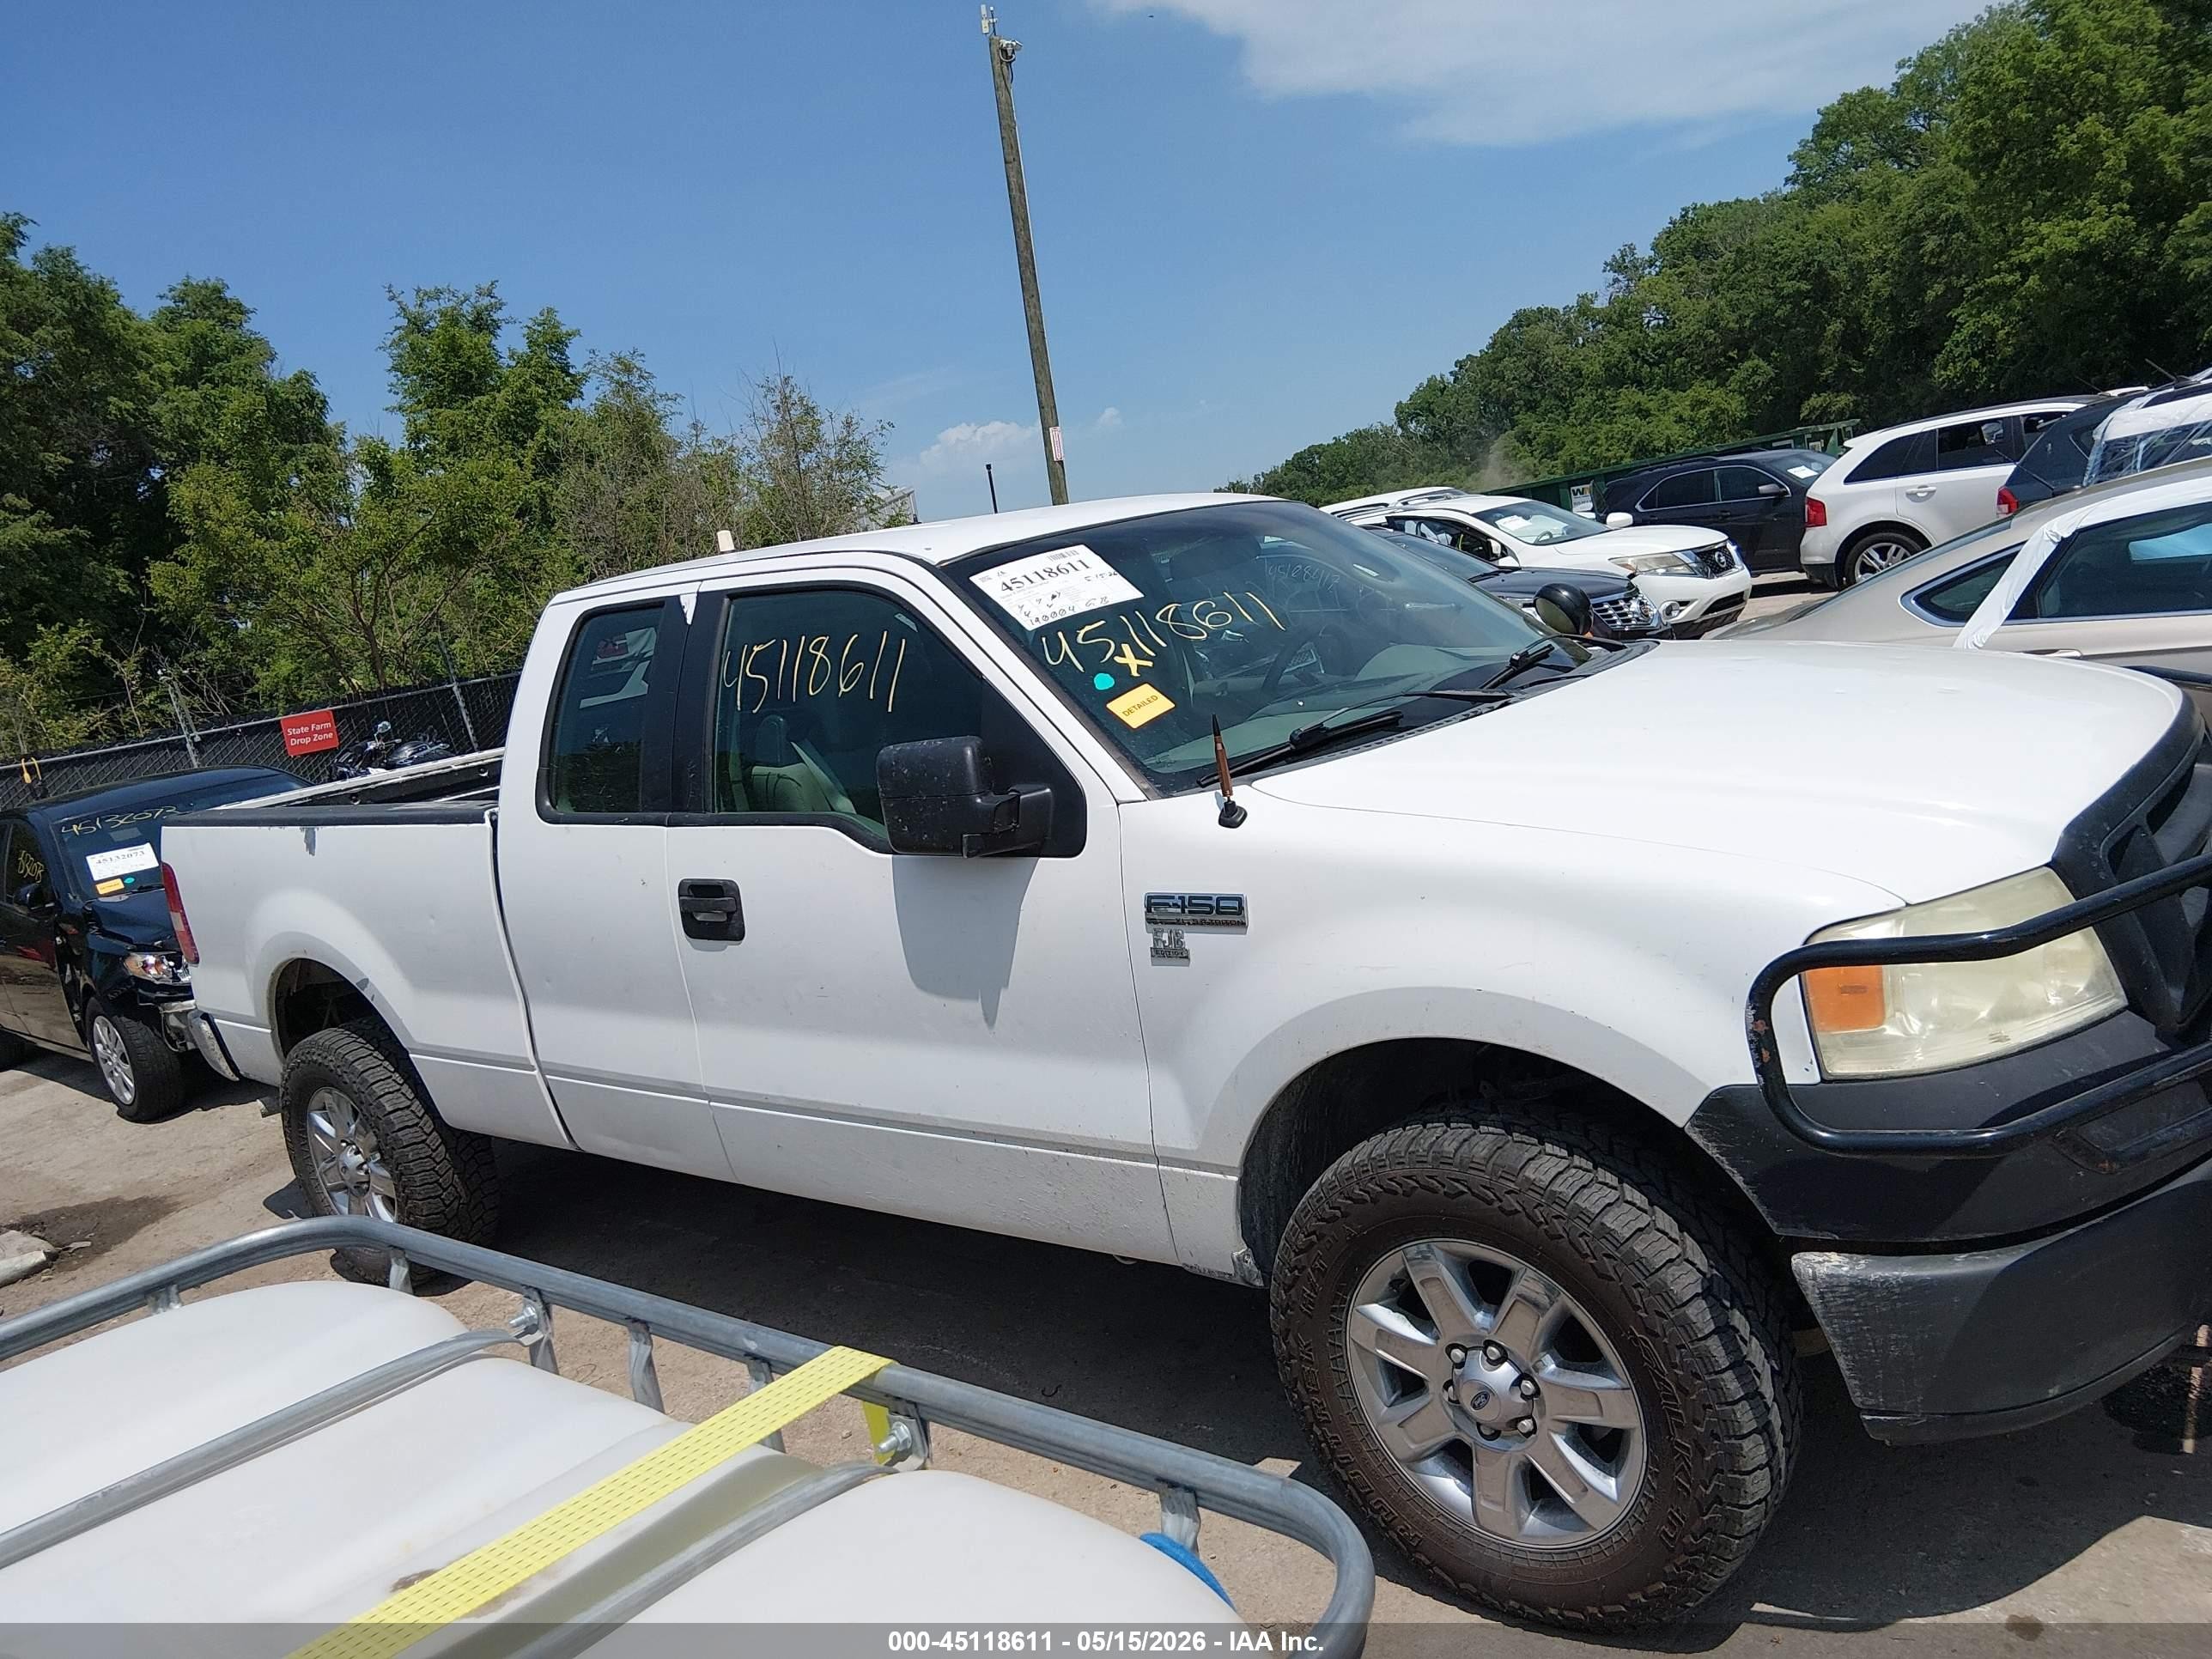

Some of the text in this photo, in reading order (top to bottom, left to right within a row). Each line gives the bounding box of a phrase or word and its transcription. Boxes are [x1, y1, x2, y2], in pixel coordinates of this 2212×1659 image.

[1000, 559, 1093, 592] 45118611
[1042, 591, 1286, 673] 45118611
[722, 629, 907, 714] 45118611
[1121, 695, 1159, 717] DETAILED
[287, 721, 331, 736] State Farm
[290, 732, 333, 746] Drop Zone
